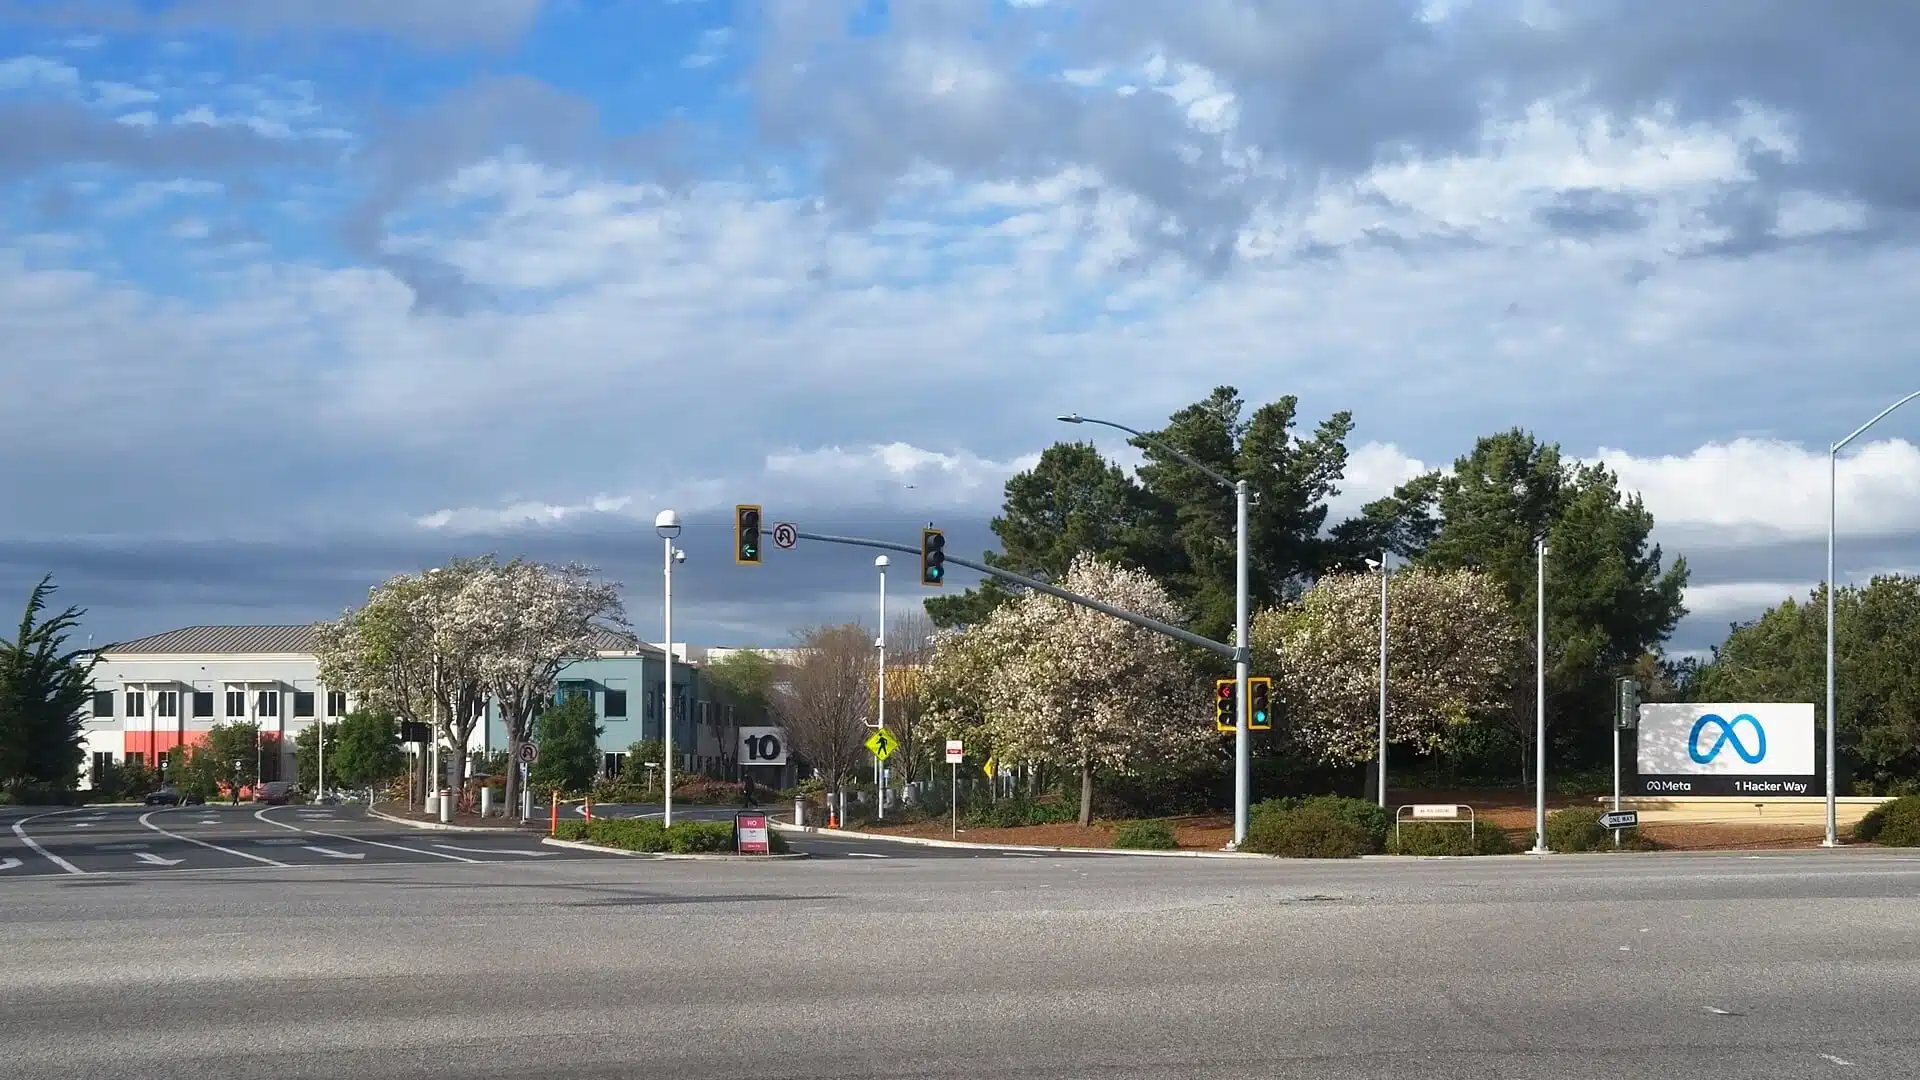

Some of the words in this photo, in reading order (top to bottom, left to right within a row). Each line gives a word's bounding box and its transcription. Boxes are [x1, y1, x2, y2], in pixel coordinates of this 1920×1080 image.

[744, 734, 781, 760] 10
[1661, 781, 1691, 791] Meta
[1734, 781, 1740, 791] 1
[1743, 781, 1781, 791] Hacker
[1783, 781, 1807, 793] Way
